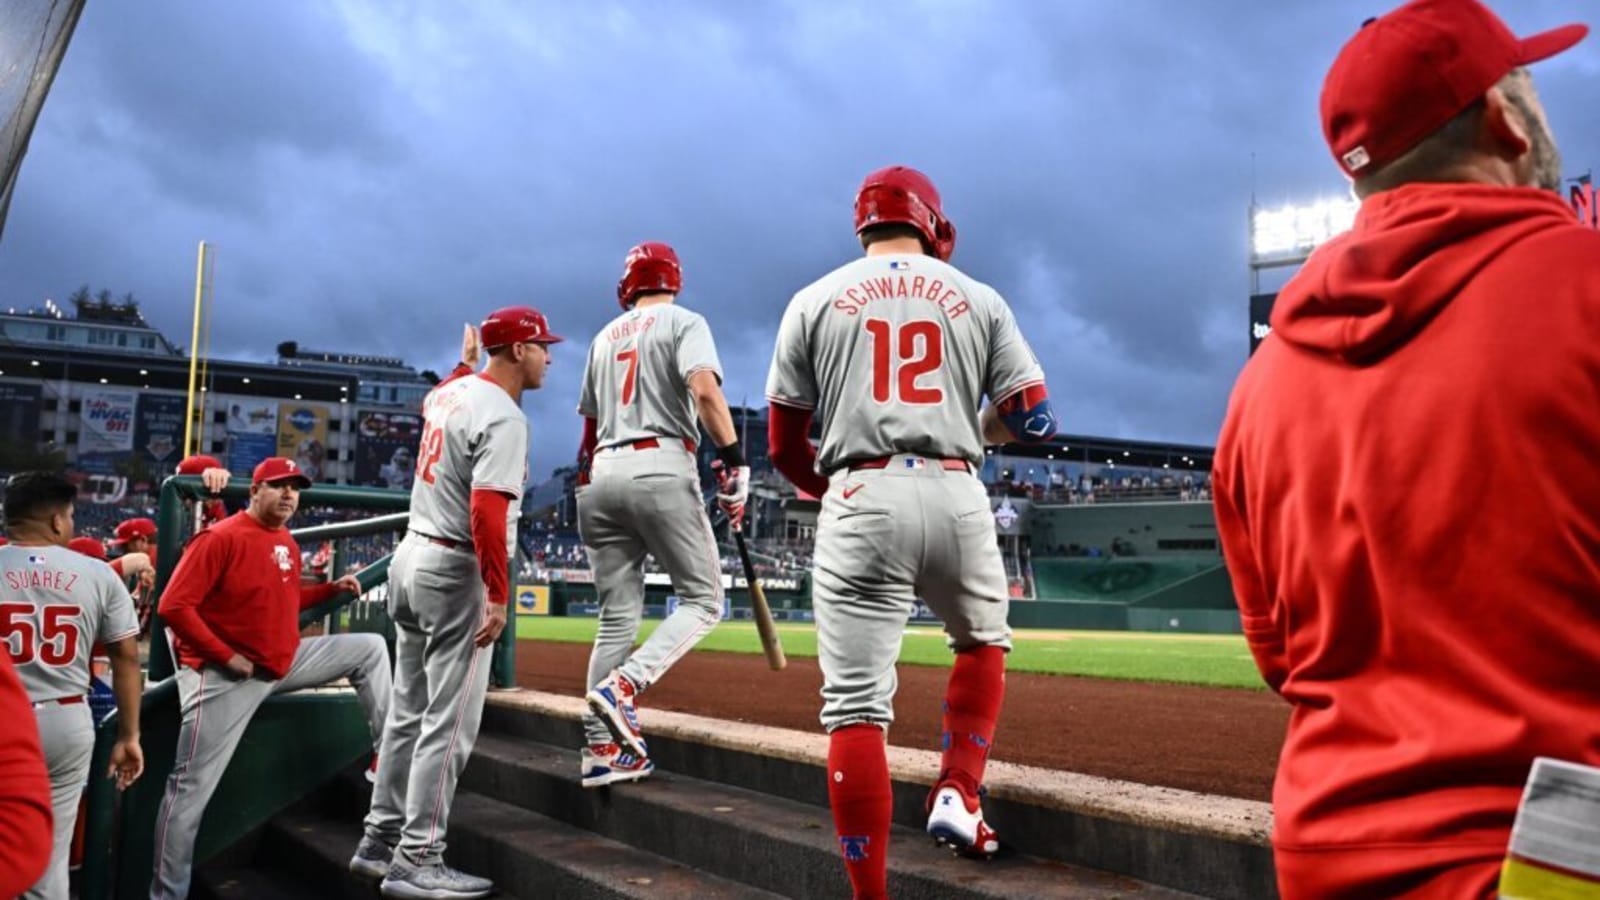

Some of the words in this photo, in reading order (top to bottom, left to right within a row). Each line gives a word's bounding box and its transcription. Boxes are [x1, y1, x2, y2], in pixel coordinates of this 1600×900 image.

[834, 275, 971, 319] SCHWARBER
[606, 316, 656, 342] TURER
[616, 349, 638, 406] 7
[865, 318, 944, 405] 12
[89, 409, 131, 420] HVAC
[6, 570, 78, 592] SUAREZ
[0, 602, 81, 667] 55
